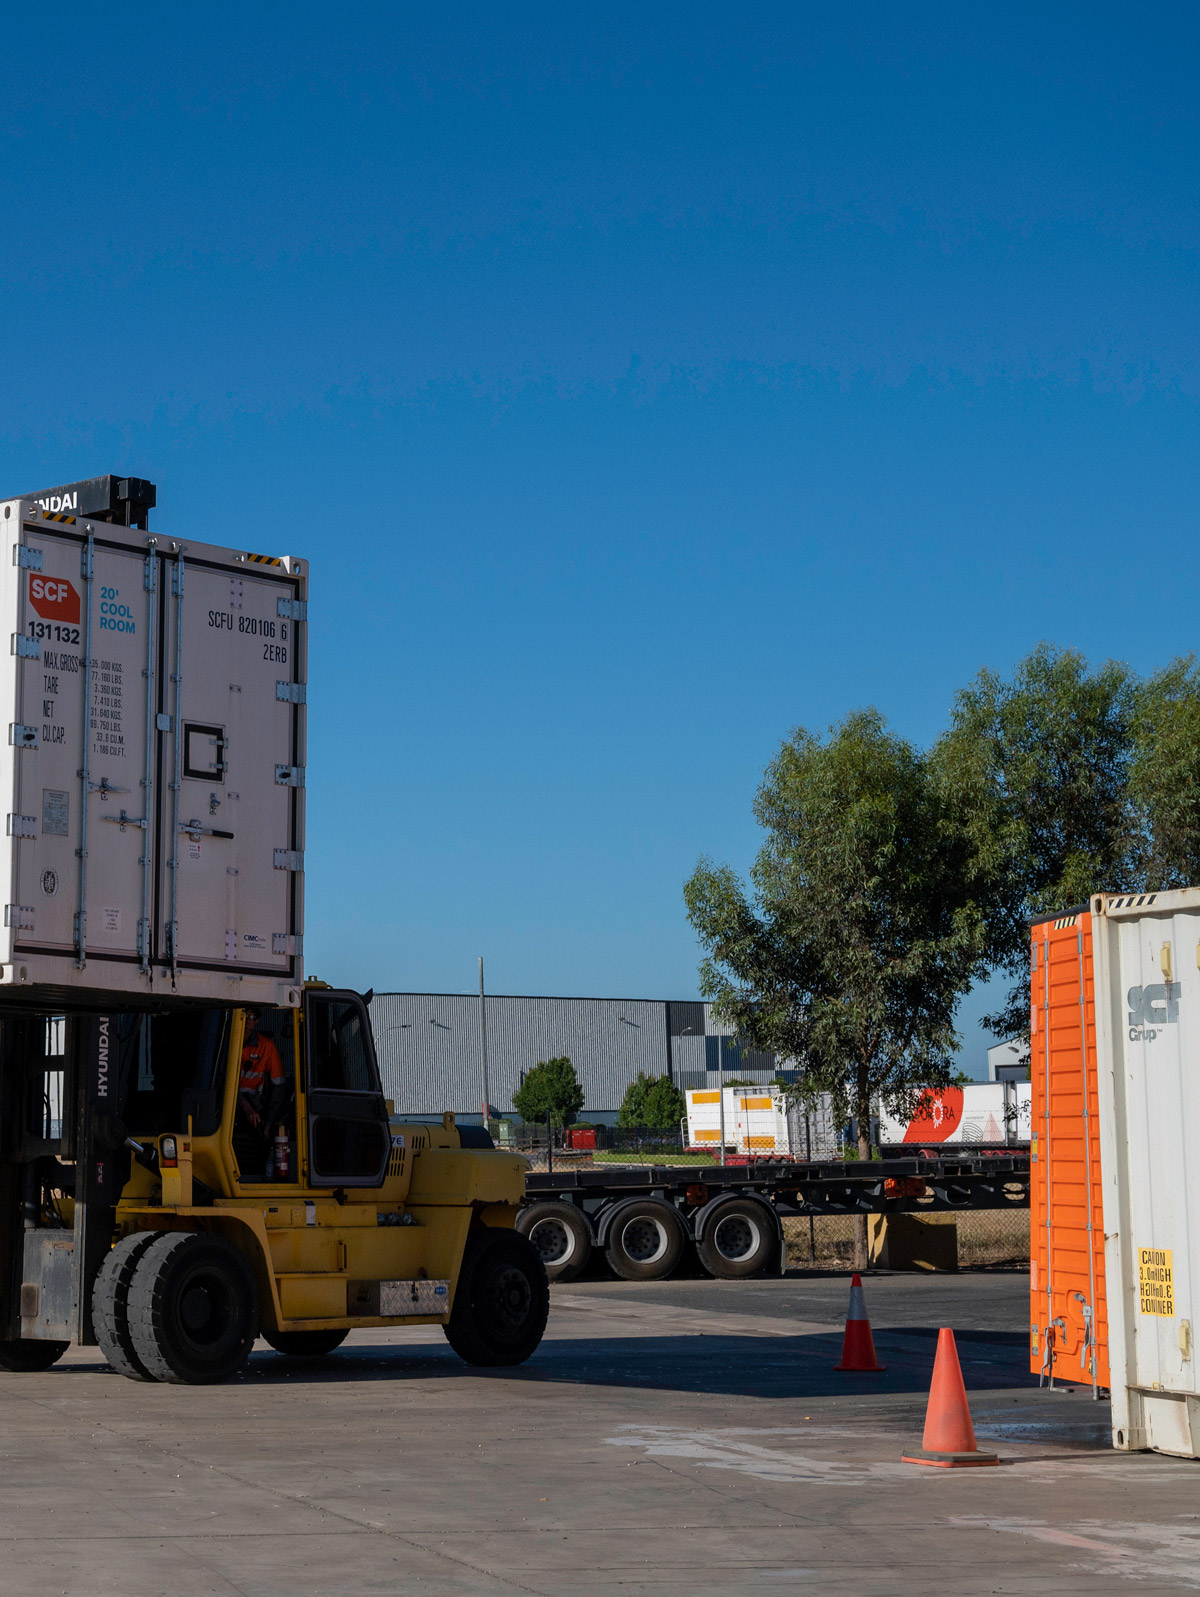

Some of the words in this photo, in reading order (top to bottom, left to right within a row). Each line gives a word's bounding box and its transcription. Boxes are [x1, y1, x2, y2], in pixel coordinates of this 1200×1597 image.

[33, 491, 78, 513] NDAI
[31, 579, 68, 603] SCF
[100, 586, 119, 600] 20'
[100, 602, 133, 618] COOL
[28, 620, 80, 645] 131132
[100, 616, 136, 634] ROOM
[208, 610, 233, 631] SCFU
[238, 616, 276, 638] 820106
[281, 623, 287, 640] 6
[263, 643, 287, 664] 2ERB
[43, 675, 59, 695] TARE
[42, 699, 54, 718] NET
[97, 1016, 110, 1097] HYUNDAI
